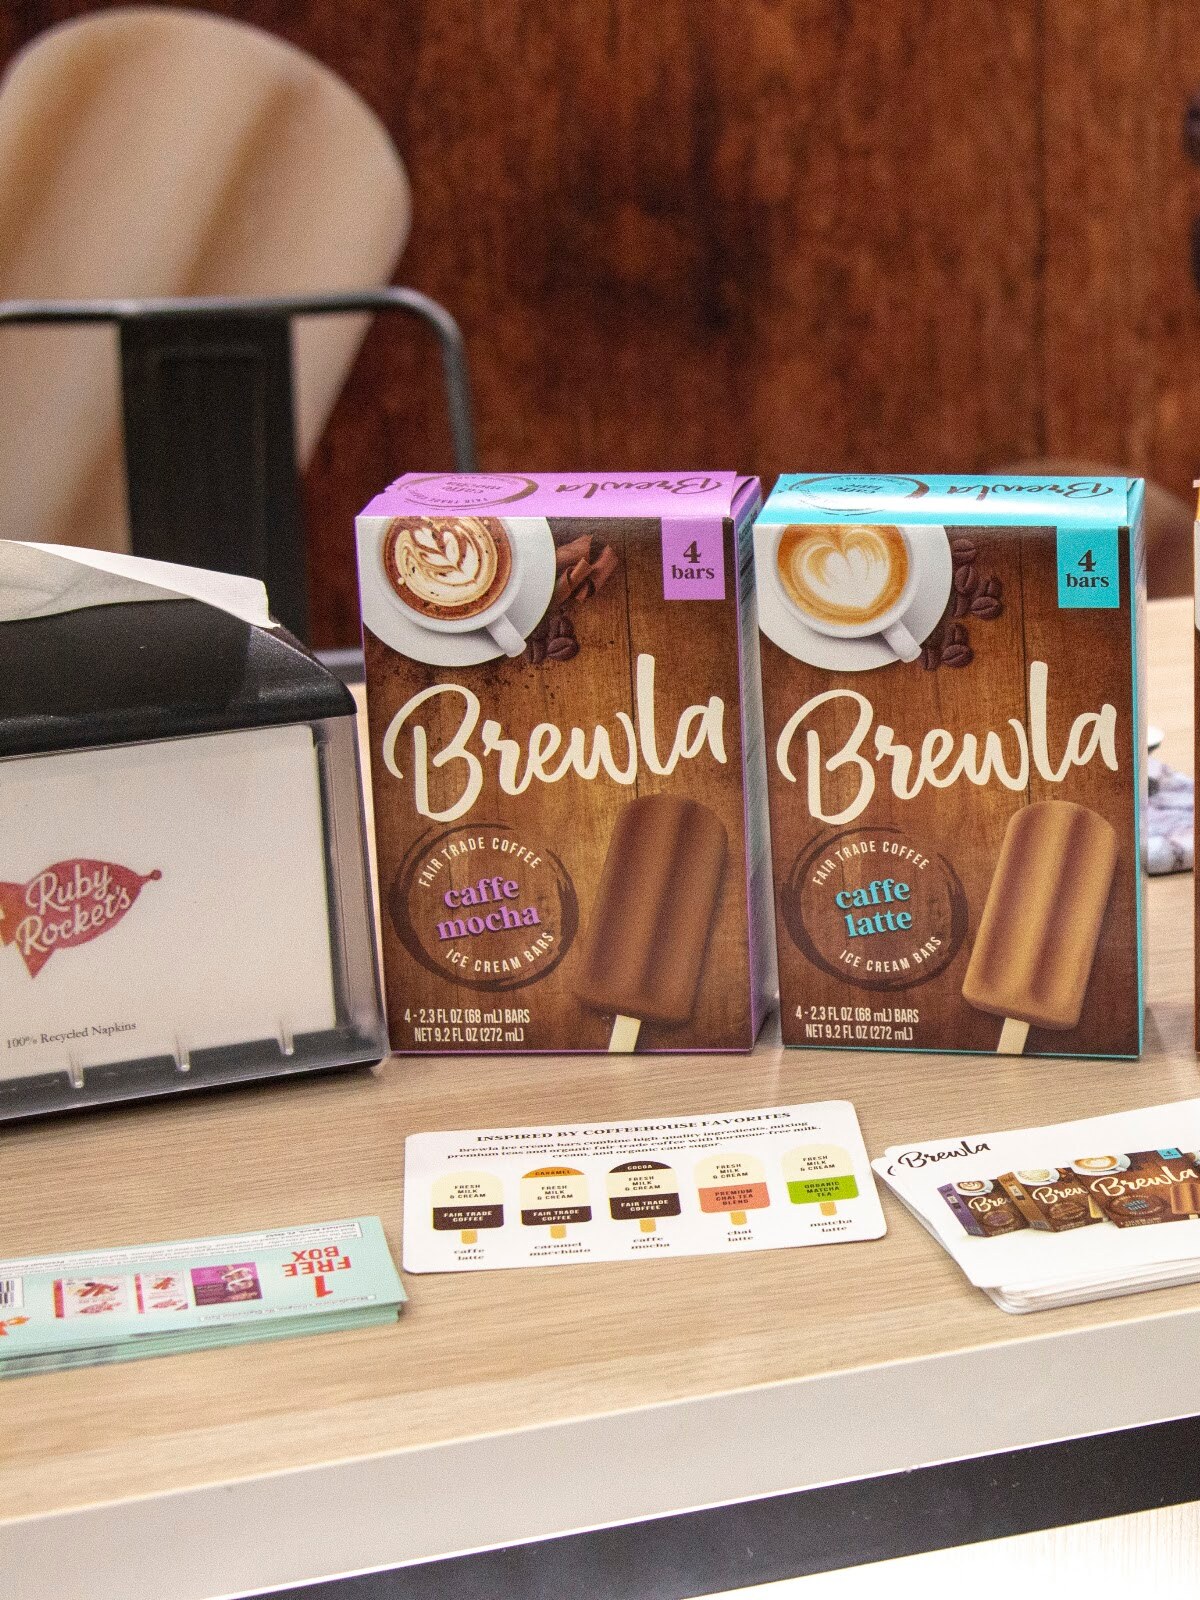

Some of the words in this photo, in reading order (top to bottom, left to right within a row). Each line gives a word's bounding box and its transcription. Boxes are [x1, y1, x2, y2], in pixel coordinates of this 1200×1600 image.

[554, 477, 724, 499] Brewla
[683, 541, 702, 564] 4
[1077, 549, 1097, 573] 4
[671, 564, 715, 581] bars
[1065, 573, 1109, 588] bars
[383, 653, 727, 822] Brewla
[776, 660, 1118, 825] Brewla
[419, 858, 443, 887] FAIR
[441, 836, 486, 860] TRADE
[492, 837, 542, 869] COFFEE
[812, 859, 837, 886] FAIR
[835, 840, 877, 862] TRADE
[882, 841, 930, 870] COFFEE
[26, 864, 113, 916] Ruby
[443, 876, 519, 908] caffe
[835, 878, 911, 909] caffe
[15, 884, 131, 955] Rocket's
[436, 905, 541, 940] mocha
[844, 910, 912, 937] latte
[446, 948, 468, 968] ICE
[474, 956, 522, 973] CREAM
[524, 931, 554, 962] BARS
[840, 949, 861, 967] ICE
[866, 957, 910, 973] CREAM
[913, 936, 942, 963] BARS
[404, 1009, 411, 1023] 4
[419, 1009, 435, 1023] 2.3
[437, 1009, 448, 1023] FL
[450, 1009, 463, 1023] OZ
[465, 1009, 481, 1023] (68
[483, 1009, 502, 1023] mL)
[505, 1009, 530, 1023] BARS
[796, 1006, 802, 1019] 4
[811, 1006, 826, 1020] 2.3
[829, 1007, 839, 1021] FL
[841, 1007, 853, 1021] OZ
[855, 1007, 871, 1022] (68
[873, 1008, 893, 1022] mL)
[894, 1008, 919, 1023] BARS
[6, 1035, 38, 1051] 100%
[40, 1027, 89, 1047] Recycled
[91, 1020, 137, 1039] Napkins
[414, 1028, 432, 1042] NET
[434, 1028, 450, 1042] 9.2
[452, 1028, 463, 1042] FL
[465, 1028, 477, 1042] OZ
[479, 1028, 501, 1042] (272
[505, 1028, 524, 1042] mL)
[806, 1024, 823, 1038] NET
[826, 1024, 841, 1038] 9.2
[843, 1025, 854, 1039] FL
[856, 1025, 868, 1039] OZ
[870, 1025, 892, 1040] (272
[895, 1026, 913, 1041] mL)
[476, 1132, 553, 1142] INSPIRED
[556, 1130, 578, 1138] BY
[583, 1121, 698, 1136] COFFEEHOUSE
[701, 1112, 791, 1127] FAVORITES
[898, 1140, 991, 1168] Brewla
[1091, 1166, 1198, 1197] Brewla
[967, 1197, 1007, 1213] Bre
[282, 1256, 352, 1278] FREE
[291, 1245, 340, 1263] BOX
[314, 1275, 334, 1299] 1
